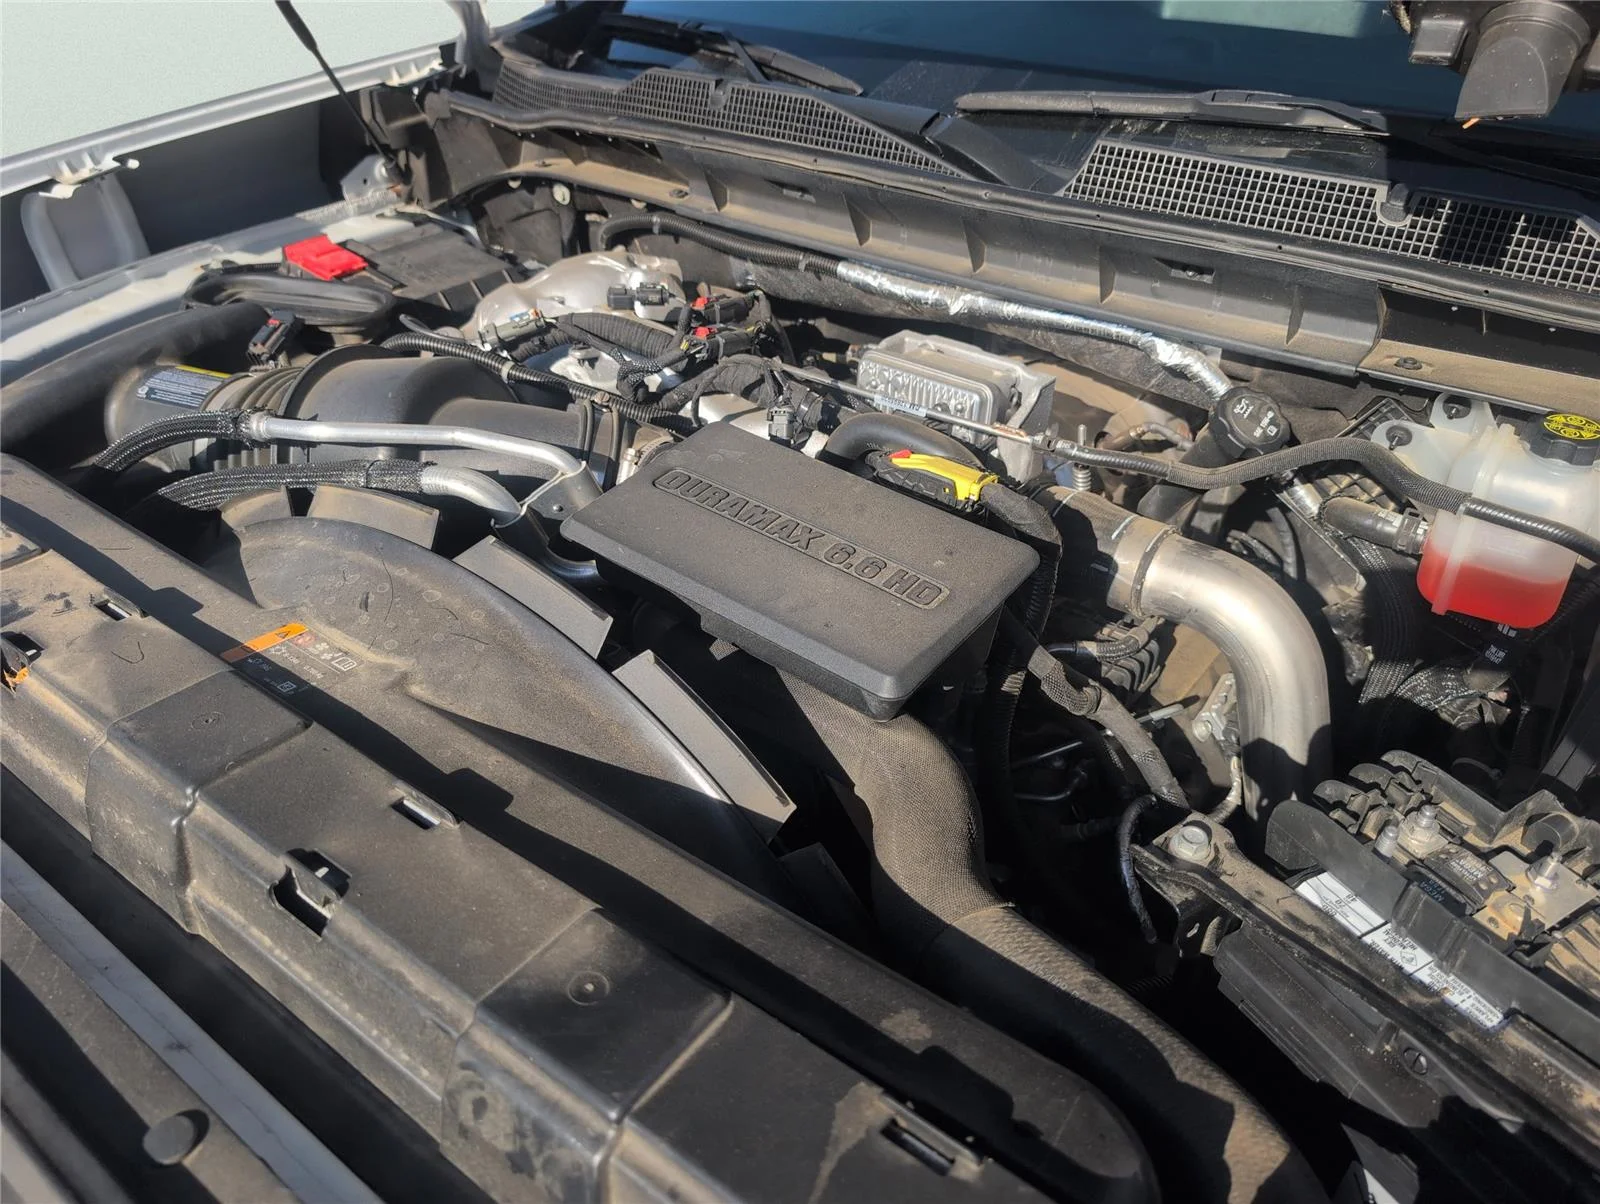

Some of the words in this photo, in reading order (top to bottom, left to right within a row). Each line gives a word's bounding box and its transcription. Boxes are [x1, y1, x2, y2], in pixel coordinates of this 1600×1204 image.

[663, 472, 826, 551] DURAMAX
[822, 542, 888, 580] 6.6
[882, 568, 943, 606] HD
[1382, 928, 1408, 950] MEDICAL
[1383, 937, 1396, 948] GET
